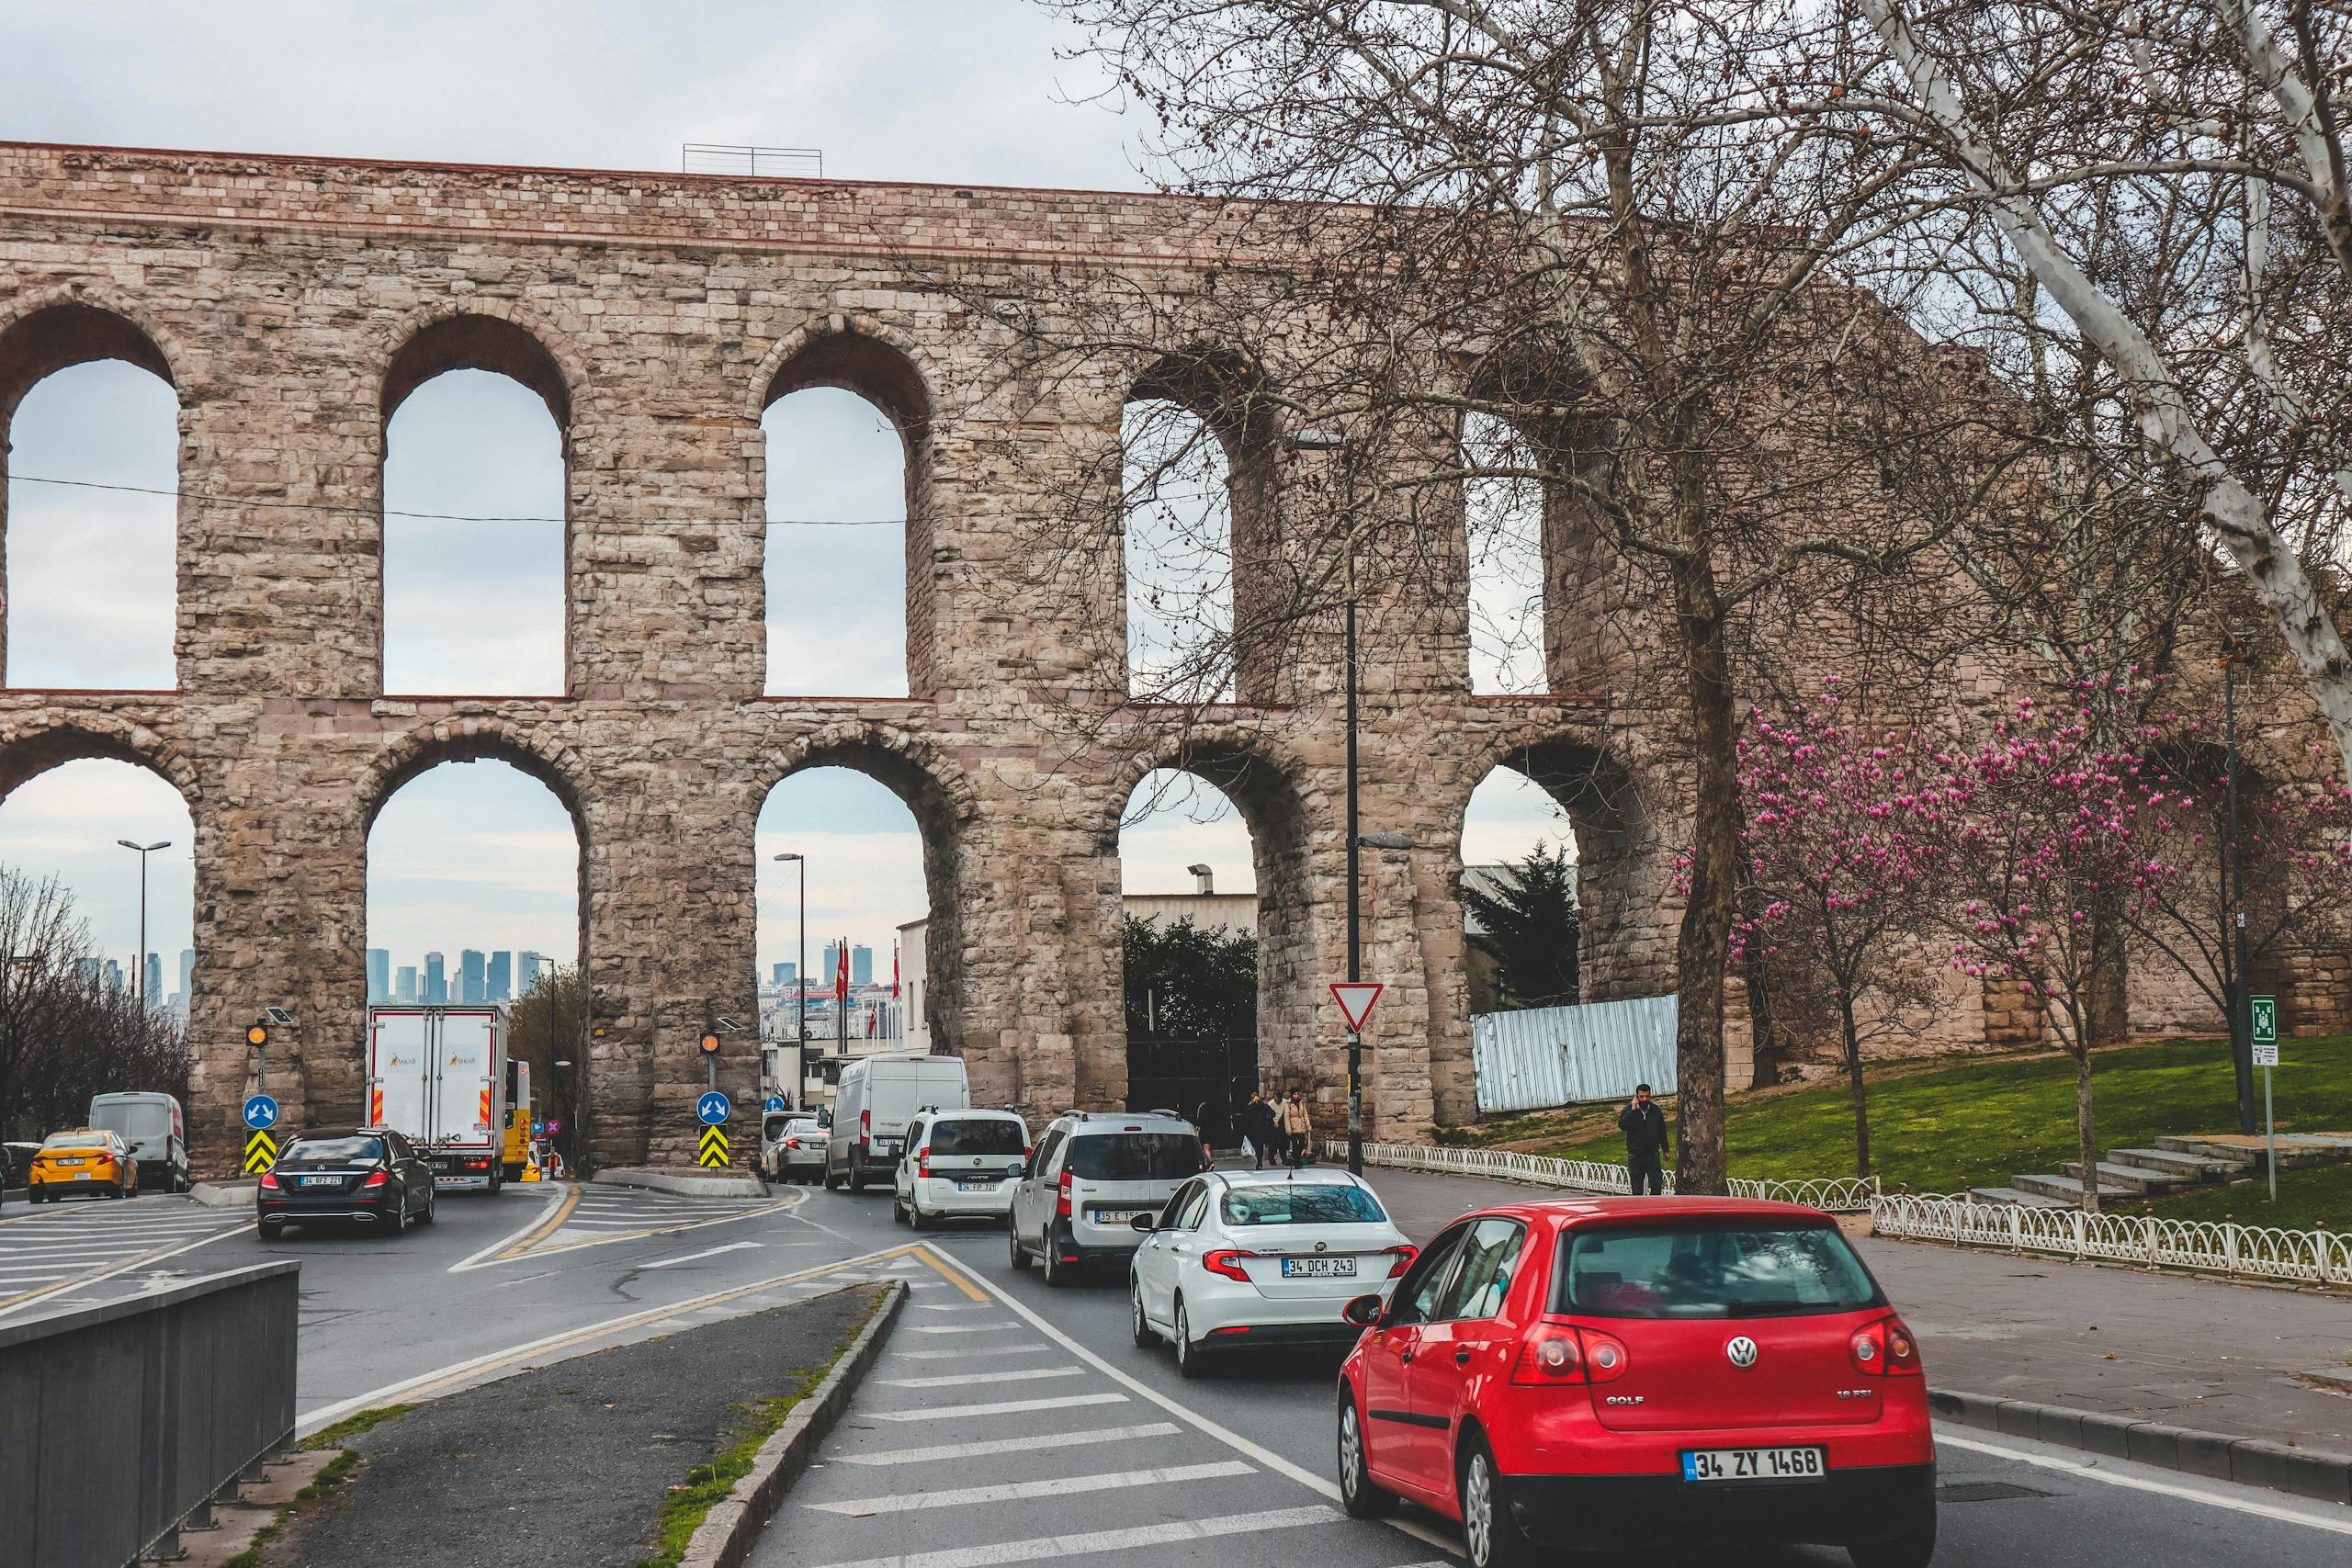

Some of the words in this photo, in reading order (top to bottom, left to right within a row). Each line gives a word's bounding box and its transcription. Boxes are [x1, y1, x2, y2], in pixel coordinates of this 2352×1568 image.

[962, 1182, 969, 1190] 34
[1101, 1212, 1111, 1221] 35
[1114, 1212, 1120, 1221] E
[1289, 1260, 1303, 1272] 34
[1307, 1260, 1328, 1272] DCH
[1333, 1259, 1353, 1272] 243
[1606, 1395, 1645, 1405] GOLF
[1696, 1453, 1724, 1478] 34
[1733, 1451, 1759, 1477] ZY
[1768, 1450, 1818, 1475] 1468
[1686, 1468, 1696, 1476] TR
